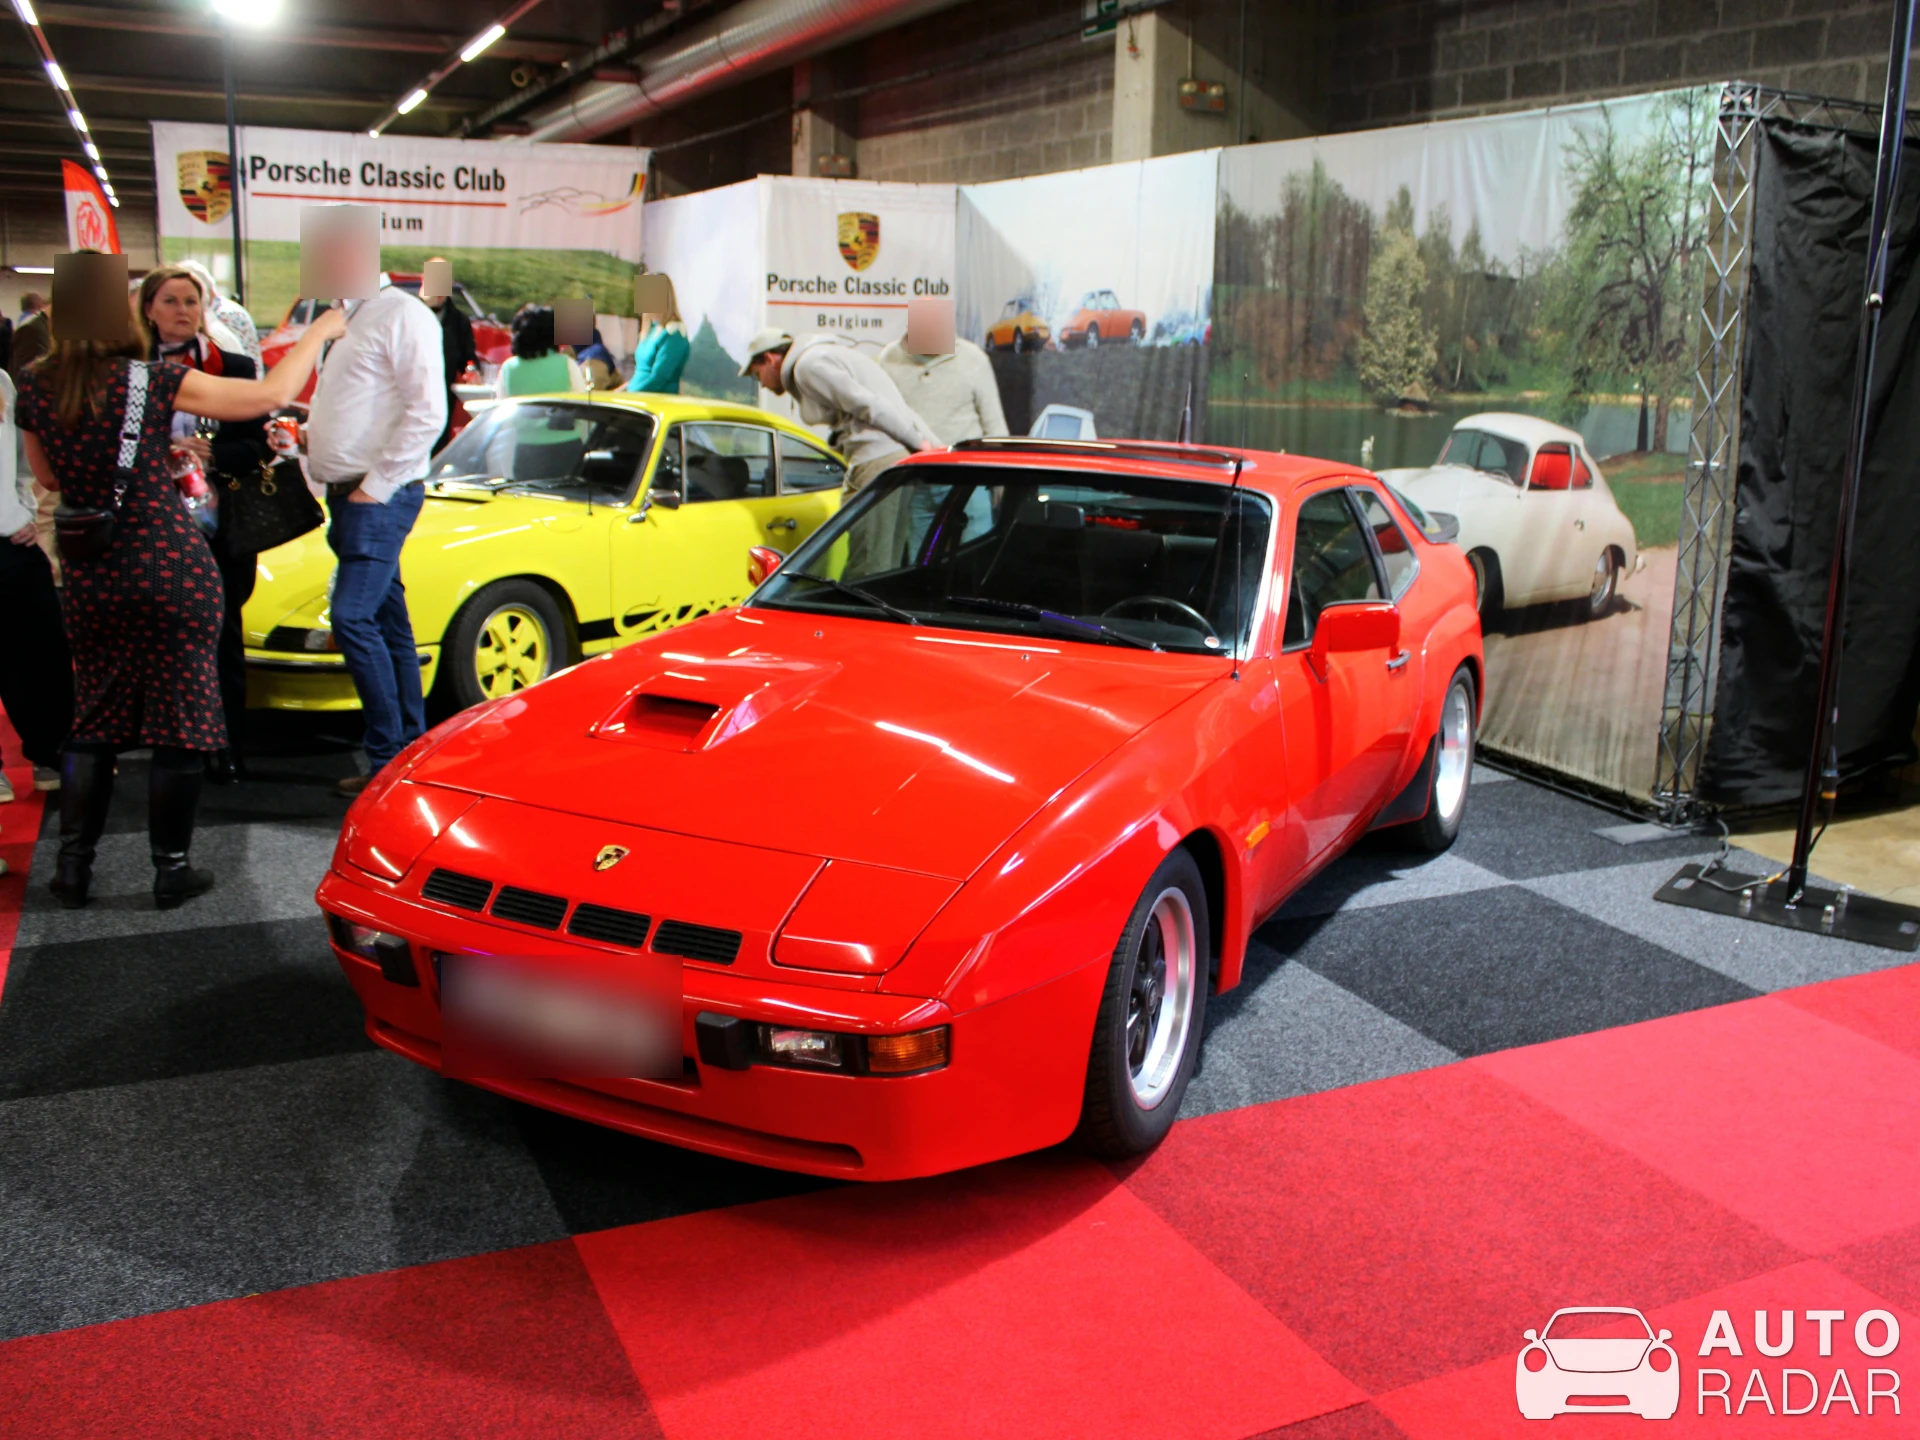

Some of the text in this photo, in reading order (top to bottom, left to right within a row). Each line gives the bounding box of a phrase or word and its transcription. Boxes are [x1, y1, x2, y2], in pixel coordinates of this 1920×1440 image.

[250, 156, 505, 191] Porsche Classic Club
[767, 274, 949, 296] Porsche Classic Club
[817, 314, 883, 330] Belgium
